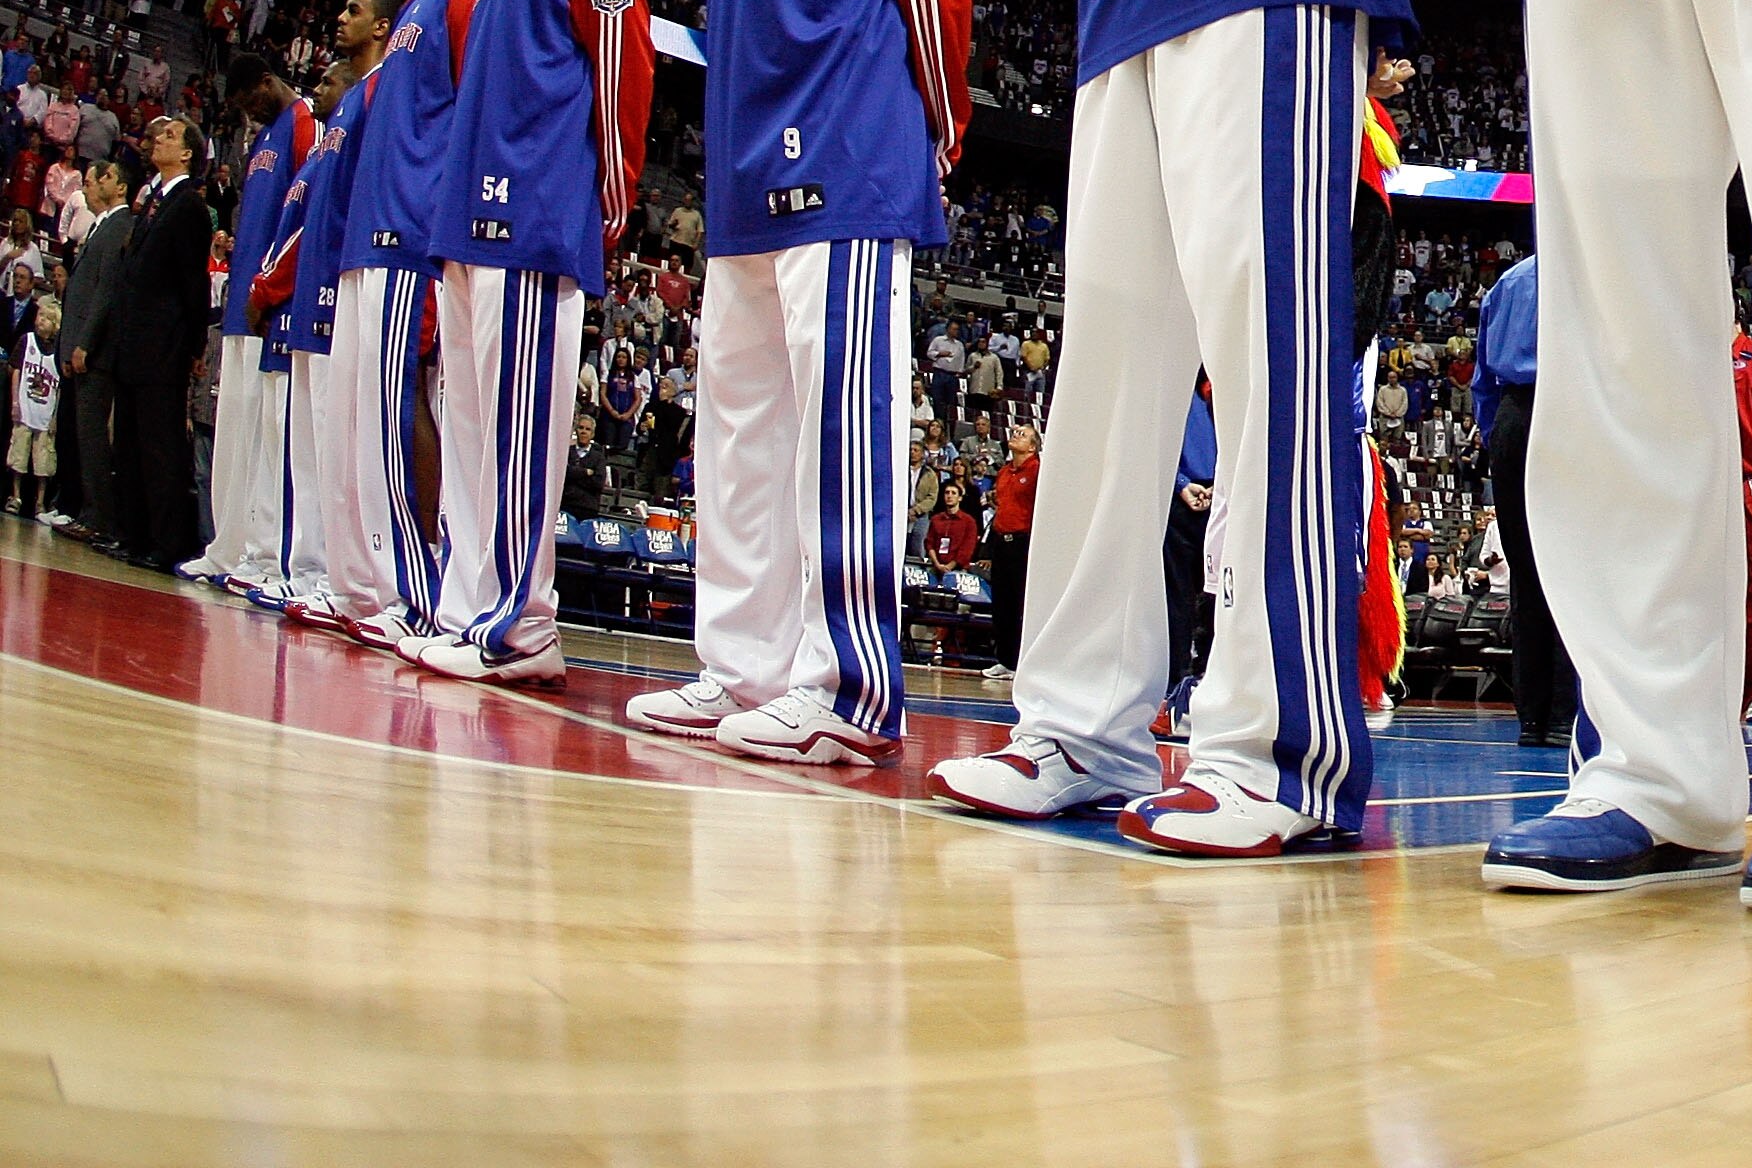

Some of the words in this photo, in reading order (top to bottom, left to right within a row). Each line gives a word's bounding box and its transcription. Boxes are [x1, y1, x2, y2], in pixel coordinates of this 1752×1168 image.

[783, 127, 801, 160] 9
[482, 175, 509, 204] 54
[318, 286, 335, 306] 28
[600, 522, 620, 533] NBA
[652, 530, 673, 542] NBA
